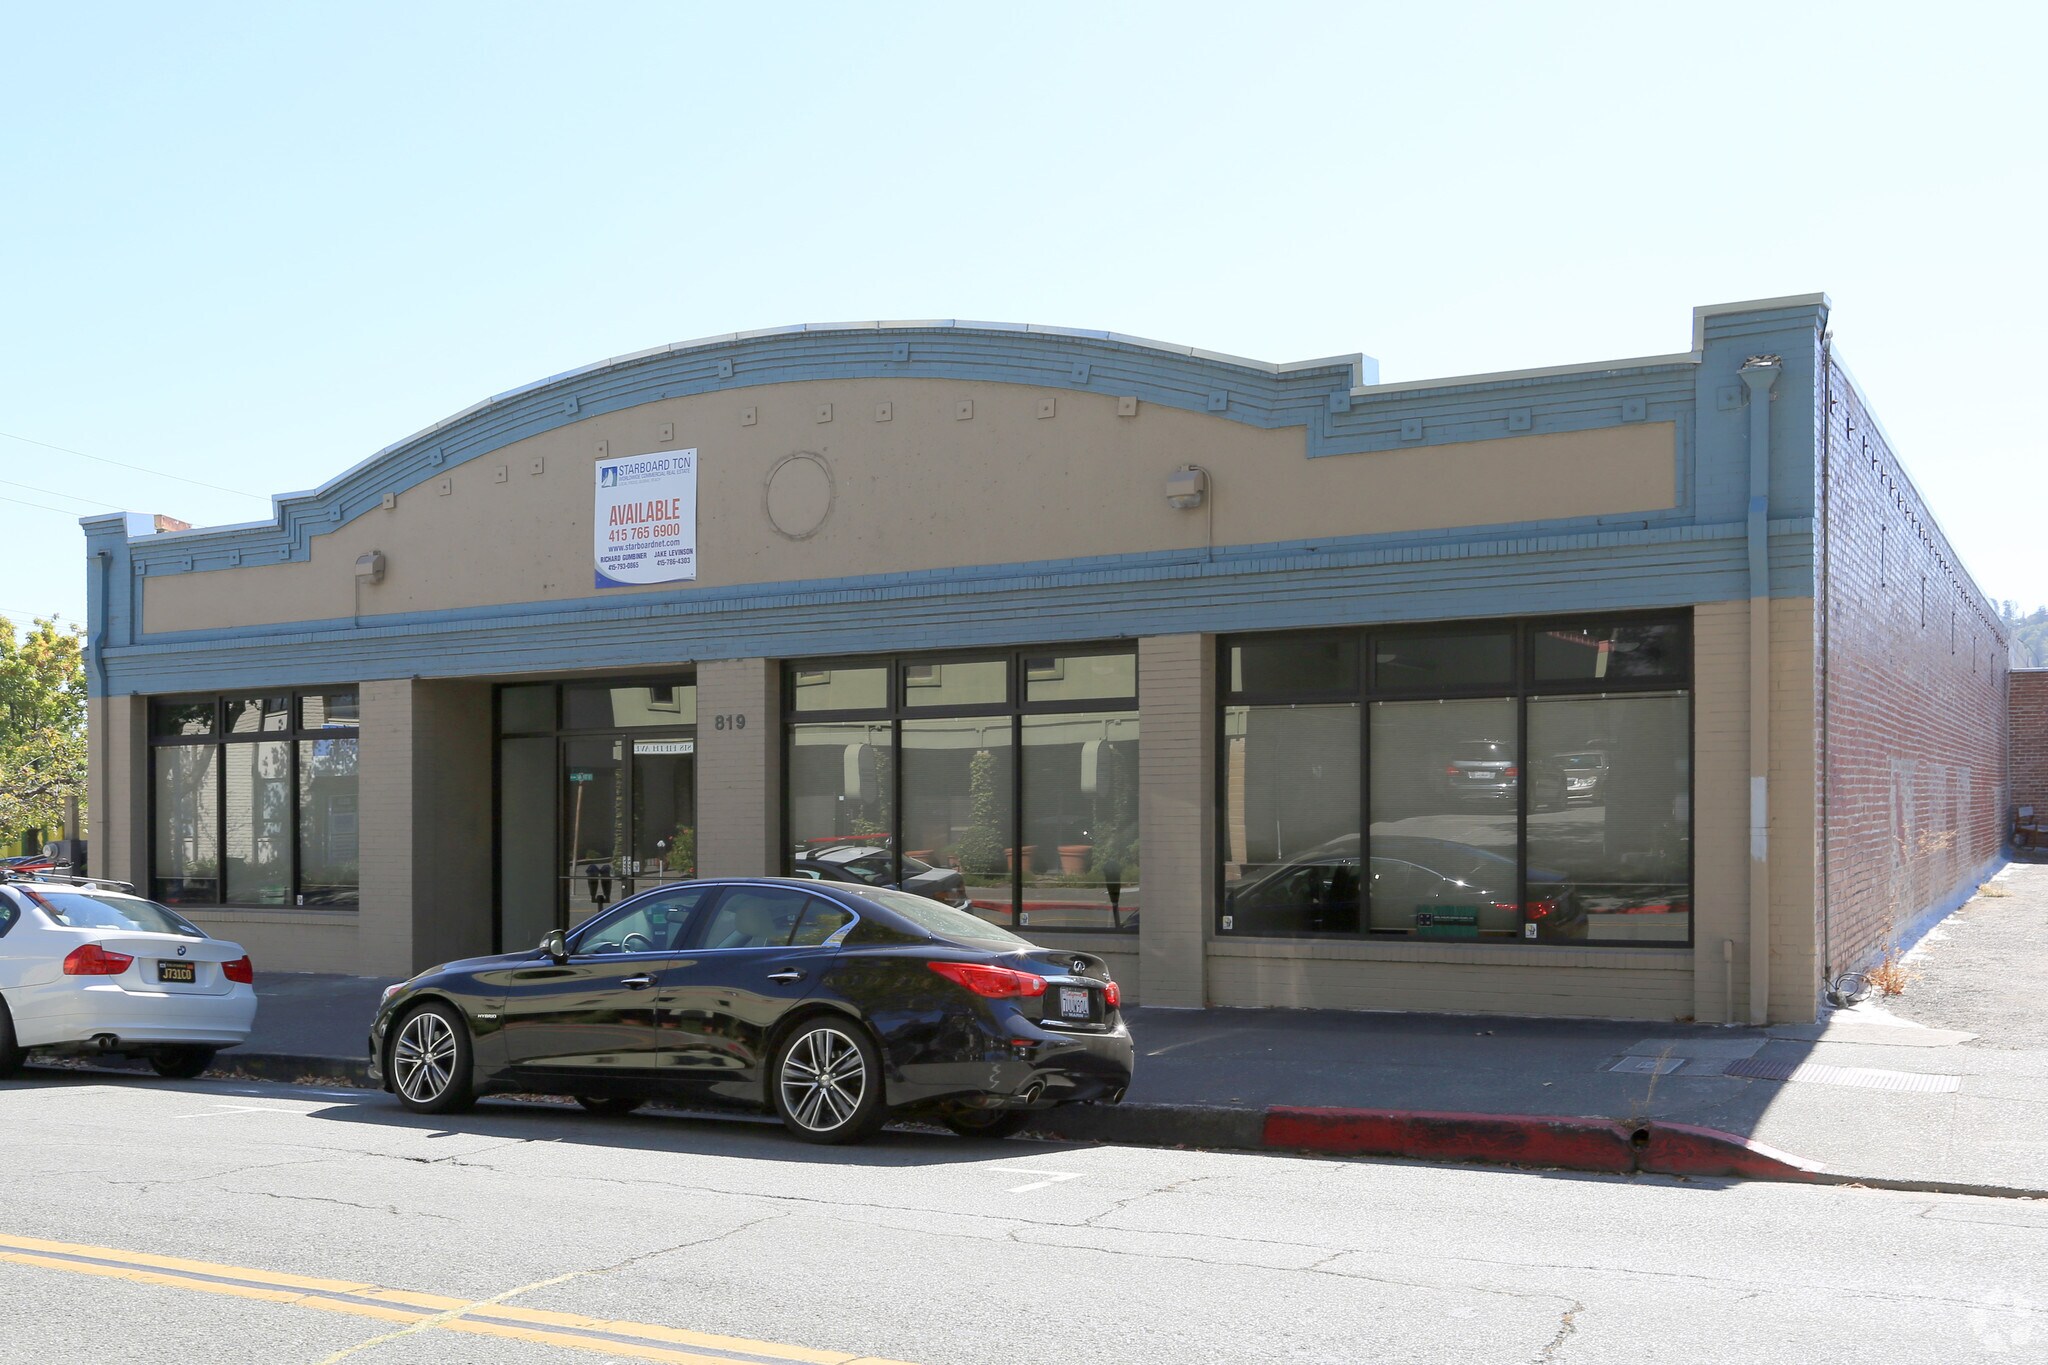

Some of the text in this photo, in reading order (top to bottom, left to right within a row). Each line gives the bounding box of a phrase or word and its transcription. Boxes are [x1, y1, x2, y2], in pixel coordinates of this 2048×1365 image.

[619, 457, 691, 476] STARBOARD TCN
[609, 498, 680, 526] AVAILABLE
[608, 523, 680, 542] 415 765 6900
[608, 539, 680, 552] www.starboardnet.com
[654, 548, 694, 558] JAKE LEVINSON
[600, 554, 621, 563] RICHARD
[715, 713, 746, 730] 819
